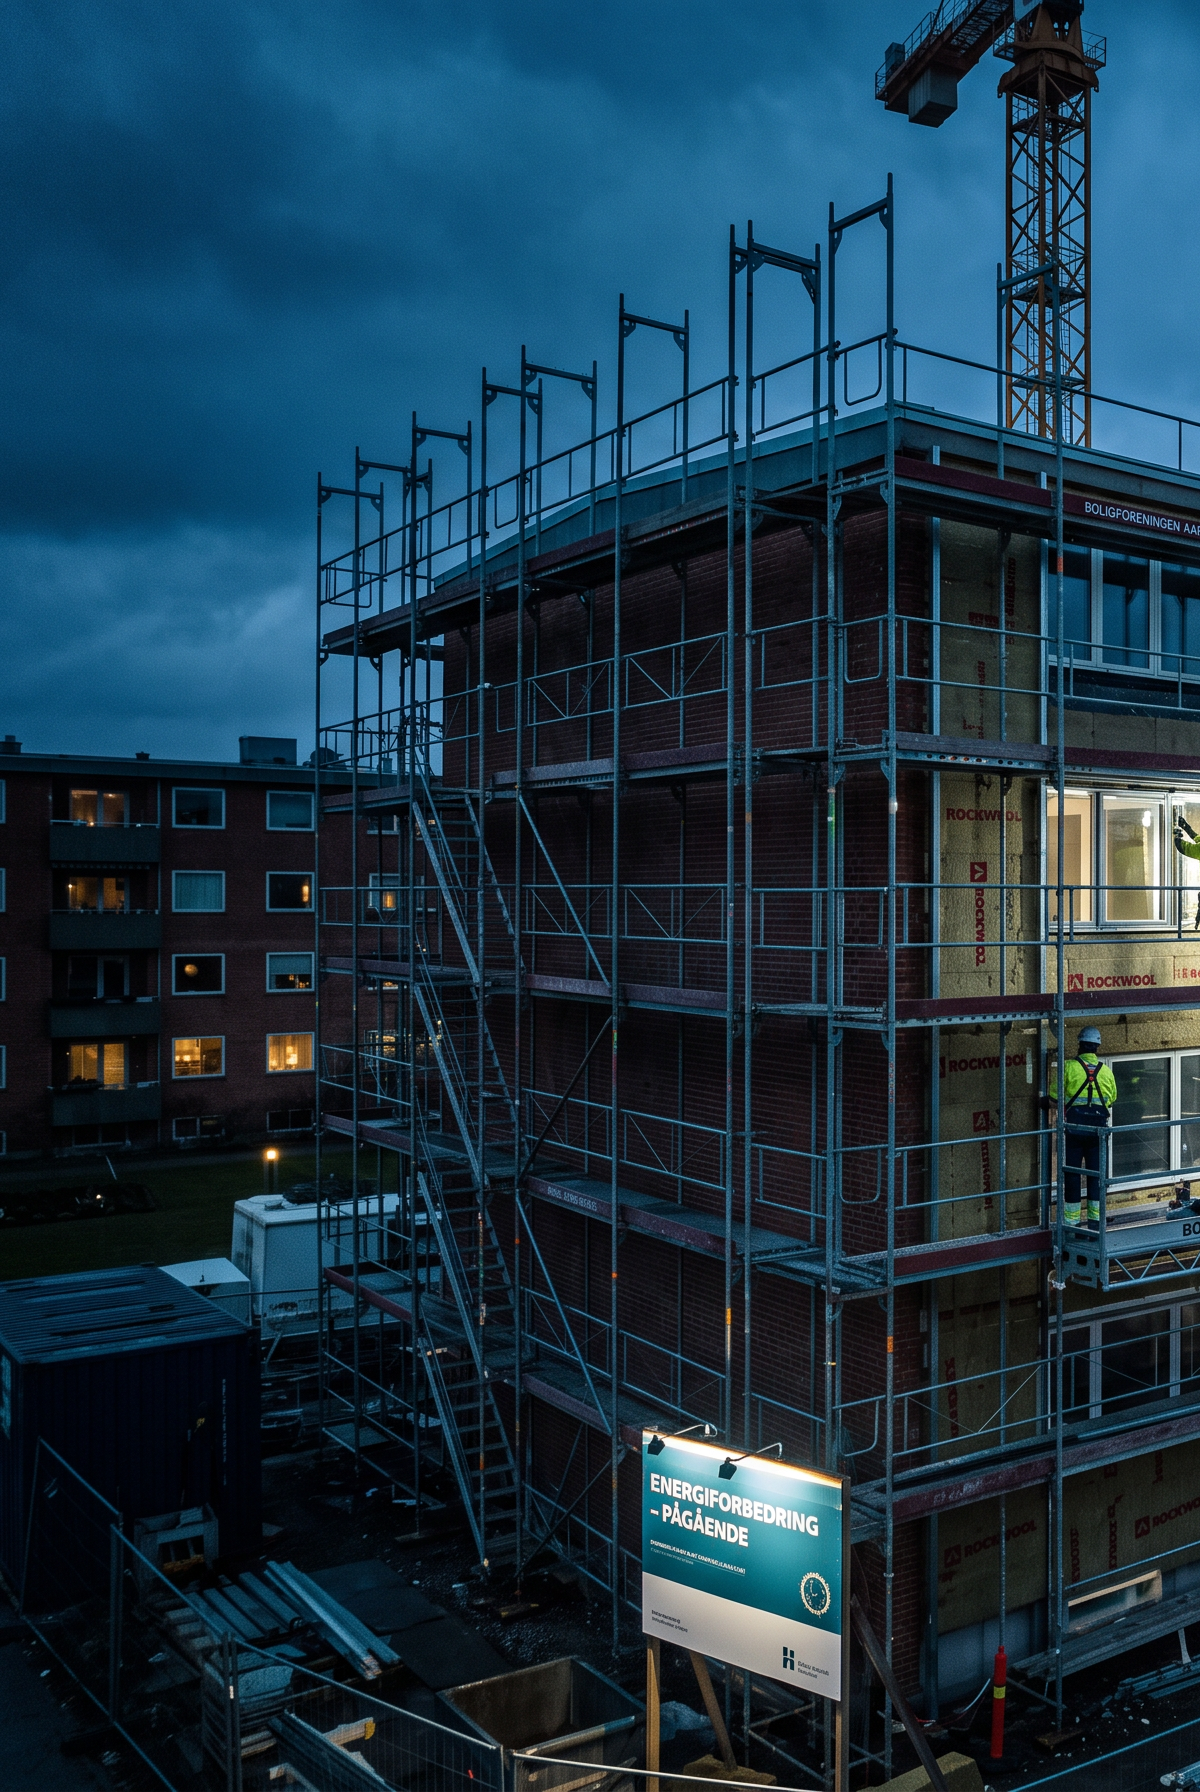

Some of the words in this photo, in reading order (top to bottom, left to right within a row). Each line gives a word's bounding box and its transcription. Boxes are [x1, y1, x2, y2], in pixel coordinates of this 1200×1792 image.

[1084, 501, 1181, 532] BOLIGFORENINGEN
[1087, 975, 1157, 989] ROCKWOOL
[650, 1473, 819, 1537] ENERGIFORBEDRING
[662, 1502, 749, 1547] PÅGÅENDE
